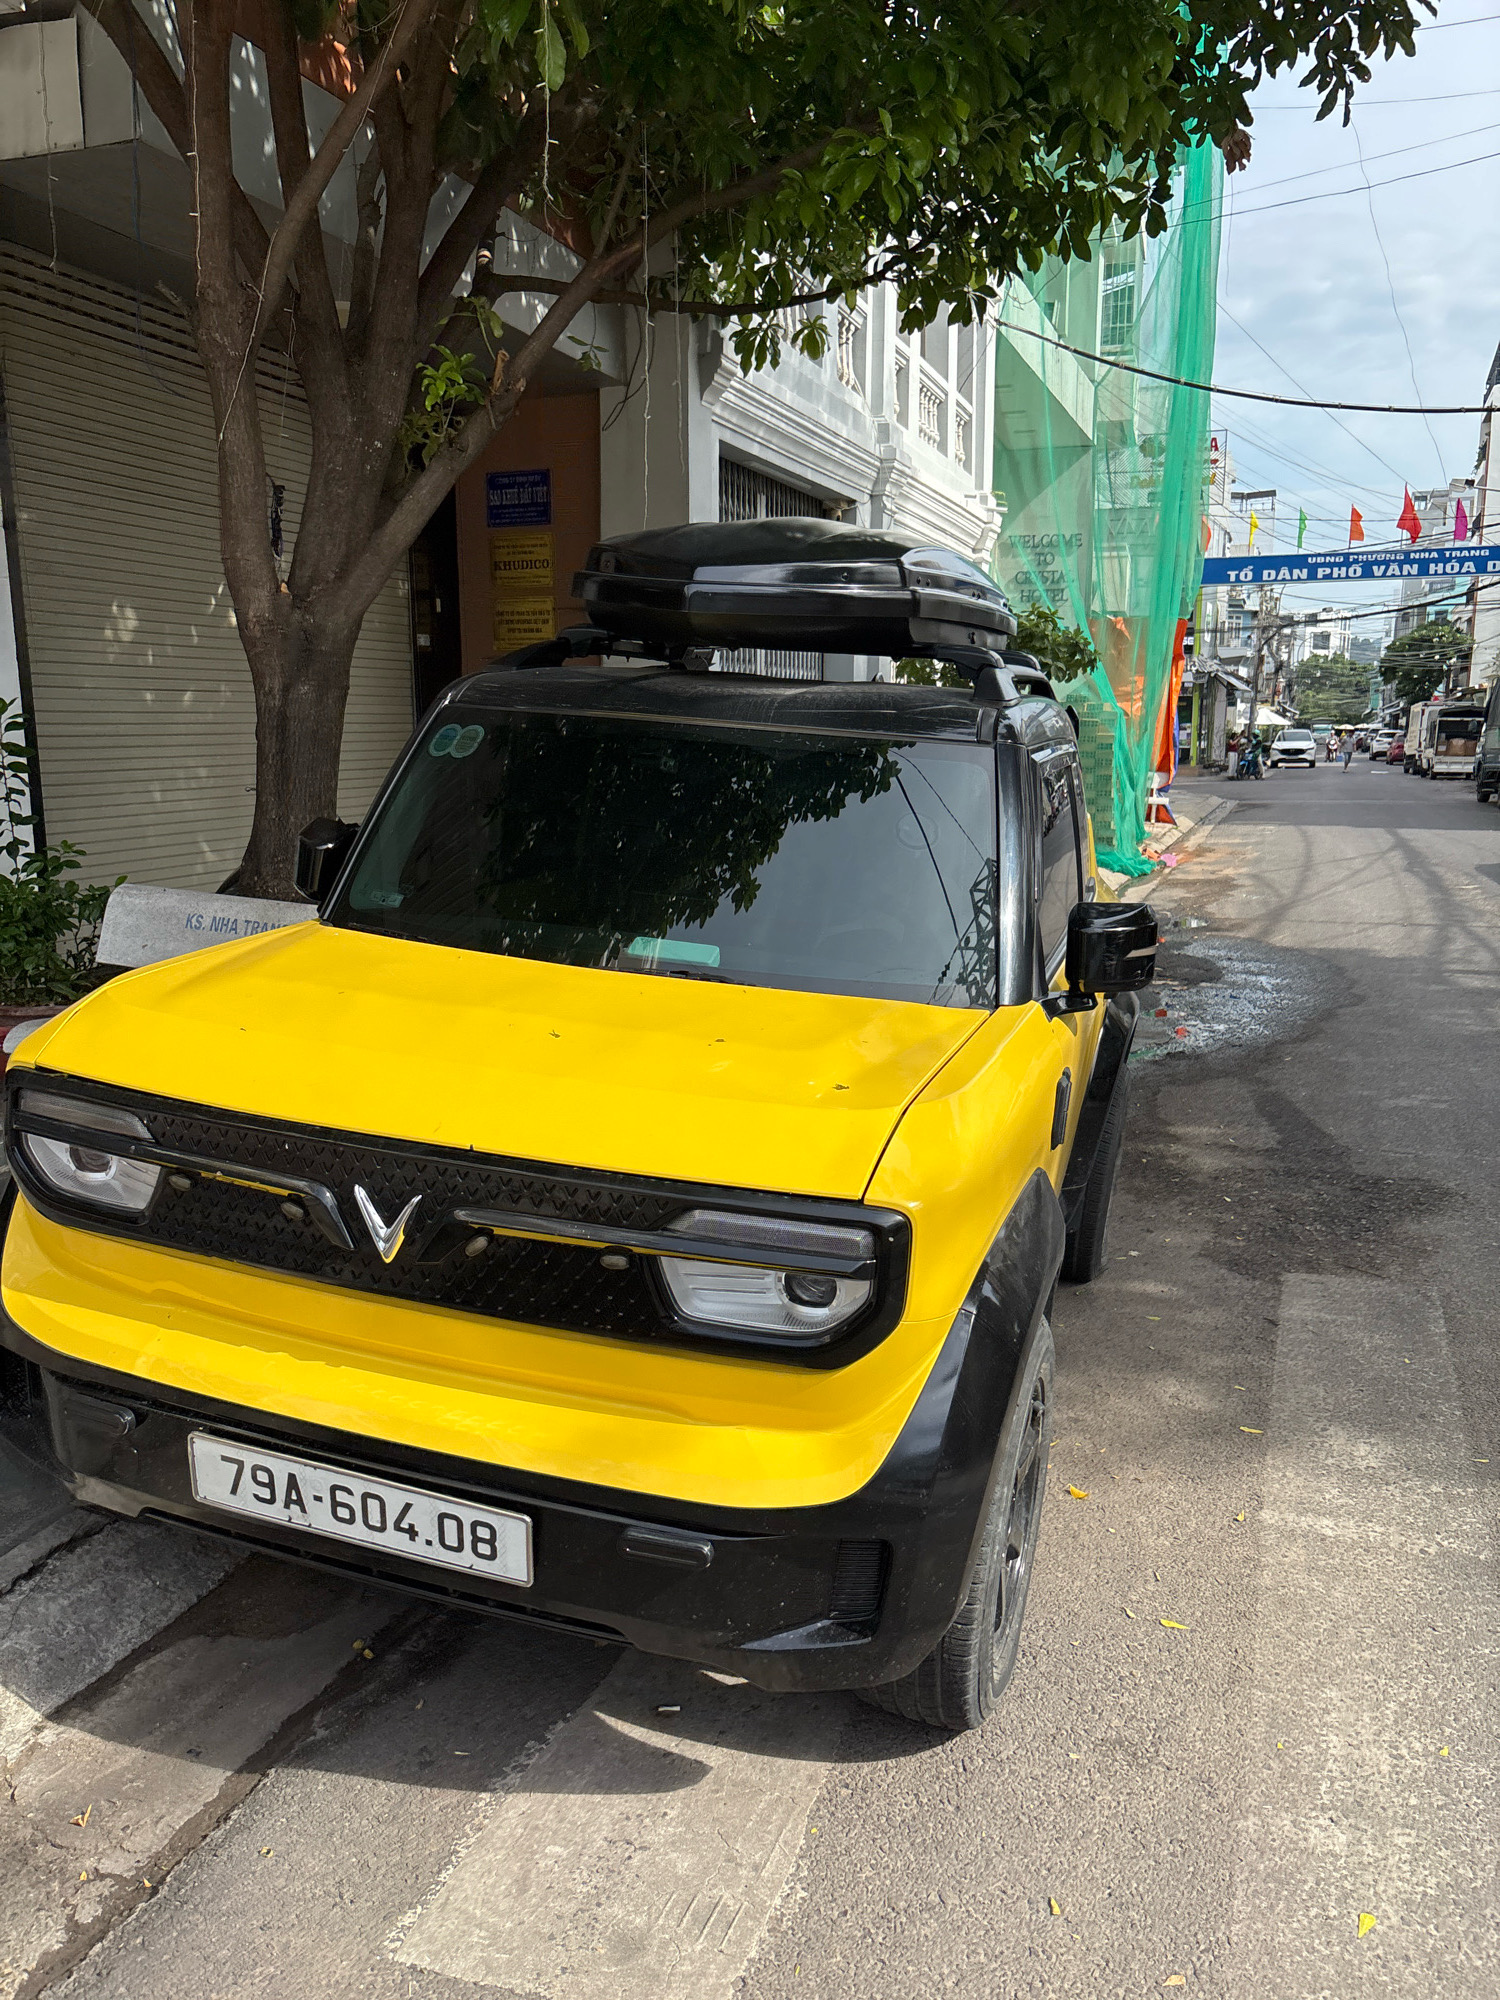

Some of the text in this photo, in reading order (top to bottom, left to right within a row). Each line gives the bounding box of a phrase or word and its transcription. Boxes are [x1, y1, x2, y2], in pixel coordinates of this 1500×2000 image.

[1008, 533, 1083, 548] WELCOME
[1035, 552, 1055, 566] TO
[1410, 551, 1439, 560] NHA
[1444, 549, 1489, 557] TRANG
[494, 558, 549, 571] KHUDICO
[1227, 565, 1254, 582] TỔ
[1262, 567, 1308, 581] DÂN
[1317, 563, 1364, 579] PHỐ
[1372, 562, 1418, 577] VĂN
[1429, 559, 1476, 575] HÓA
[1015, 570, 1074, 585] CRYSTA
[185, 913, 289, 936] KS. NHA TRA
[219, 1453, 499, 1563] 79A-604.08
